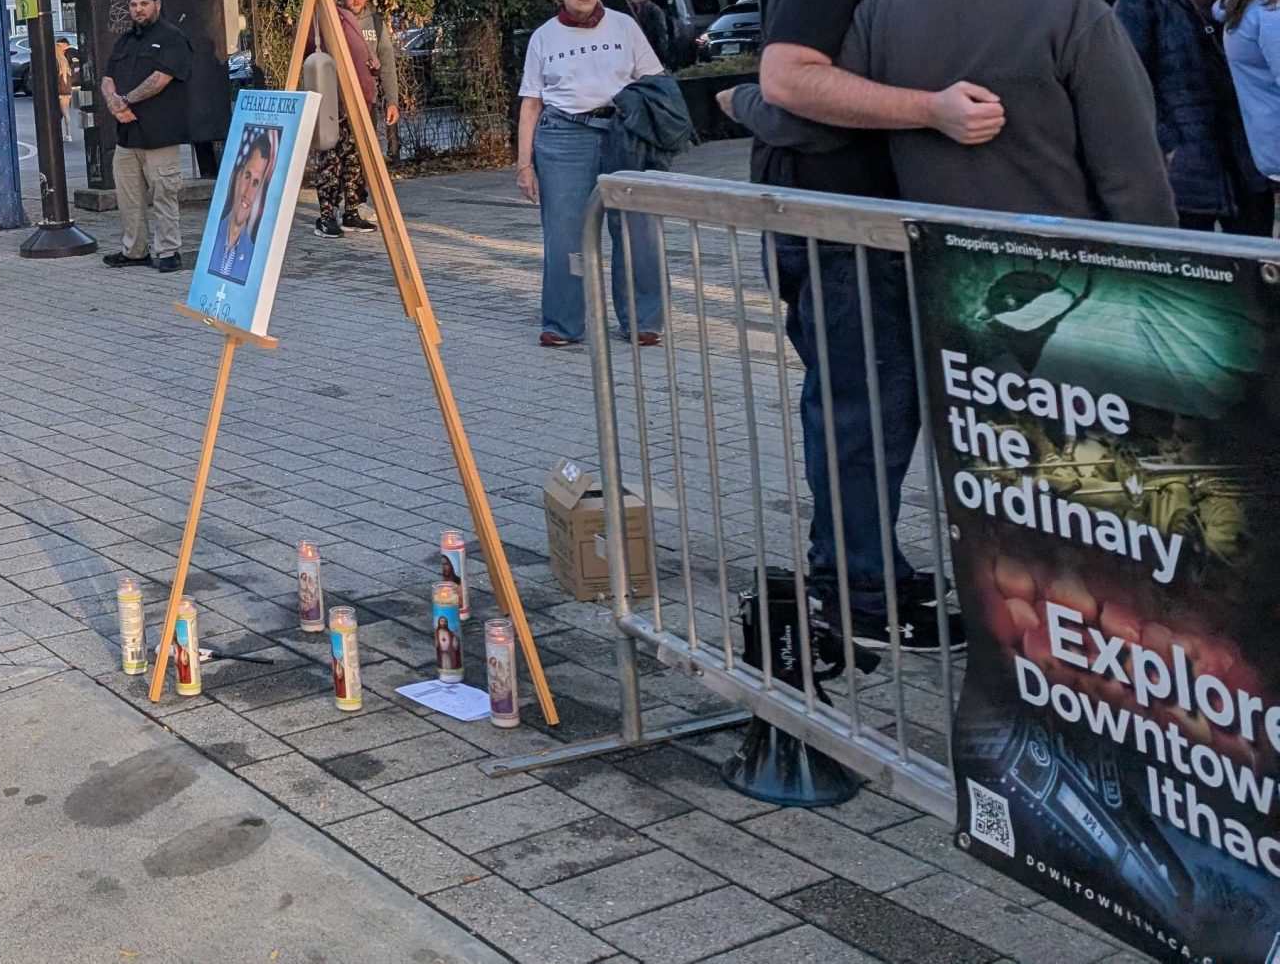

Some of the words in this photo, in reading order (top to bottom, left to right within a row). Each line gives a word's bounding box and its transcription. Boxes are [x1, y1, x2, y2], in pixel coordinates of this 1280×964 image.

[549, 43, 622, 63] FREEDOM
[241, 96, 276, 113] CHARLIE
[277, 98, 299, 114] KIRK
[945, 234, 999, 254] Shopping
[1005, 242, 1043, 260] Dining
[1050, 248, 1071, 261] Art
[1078, 250, 1173, 275] Entertainment
[1181, 263, 1234, 282] Culture
[940, 349, 1130, 437] Escape
[948, 405, 1030, 468] the
[954, 470, 1183, 584] ordinary
[1014, 654, 1280, 815] Downtow
